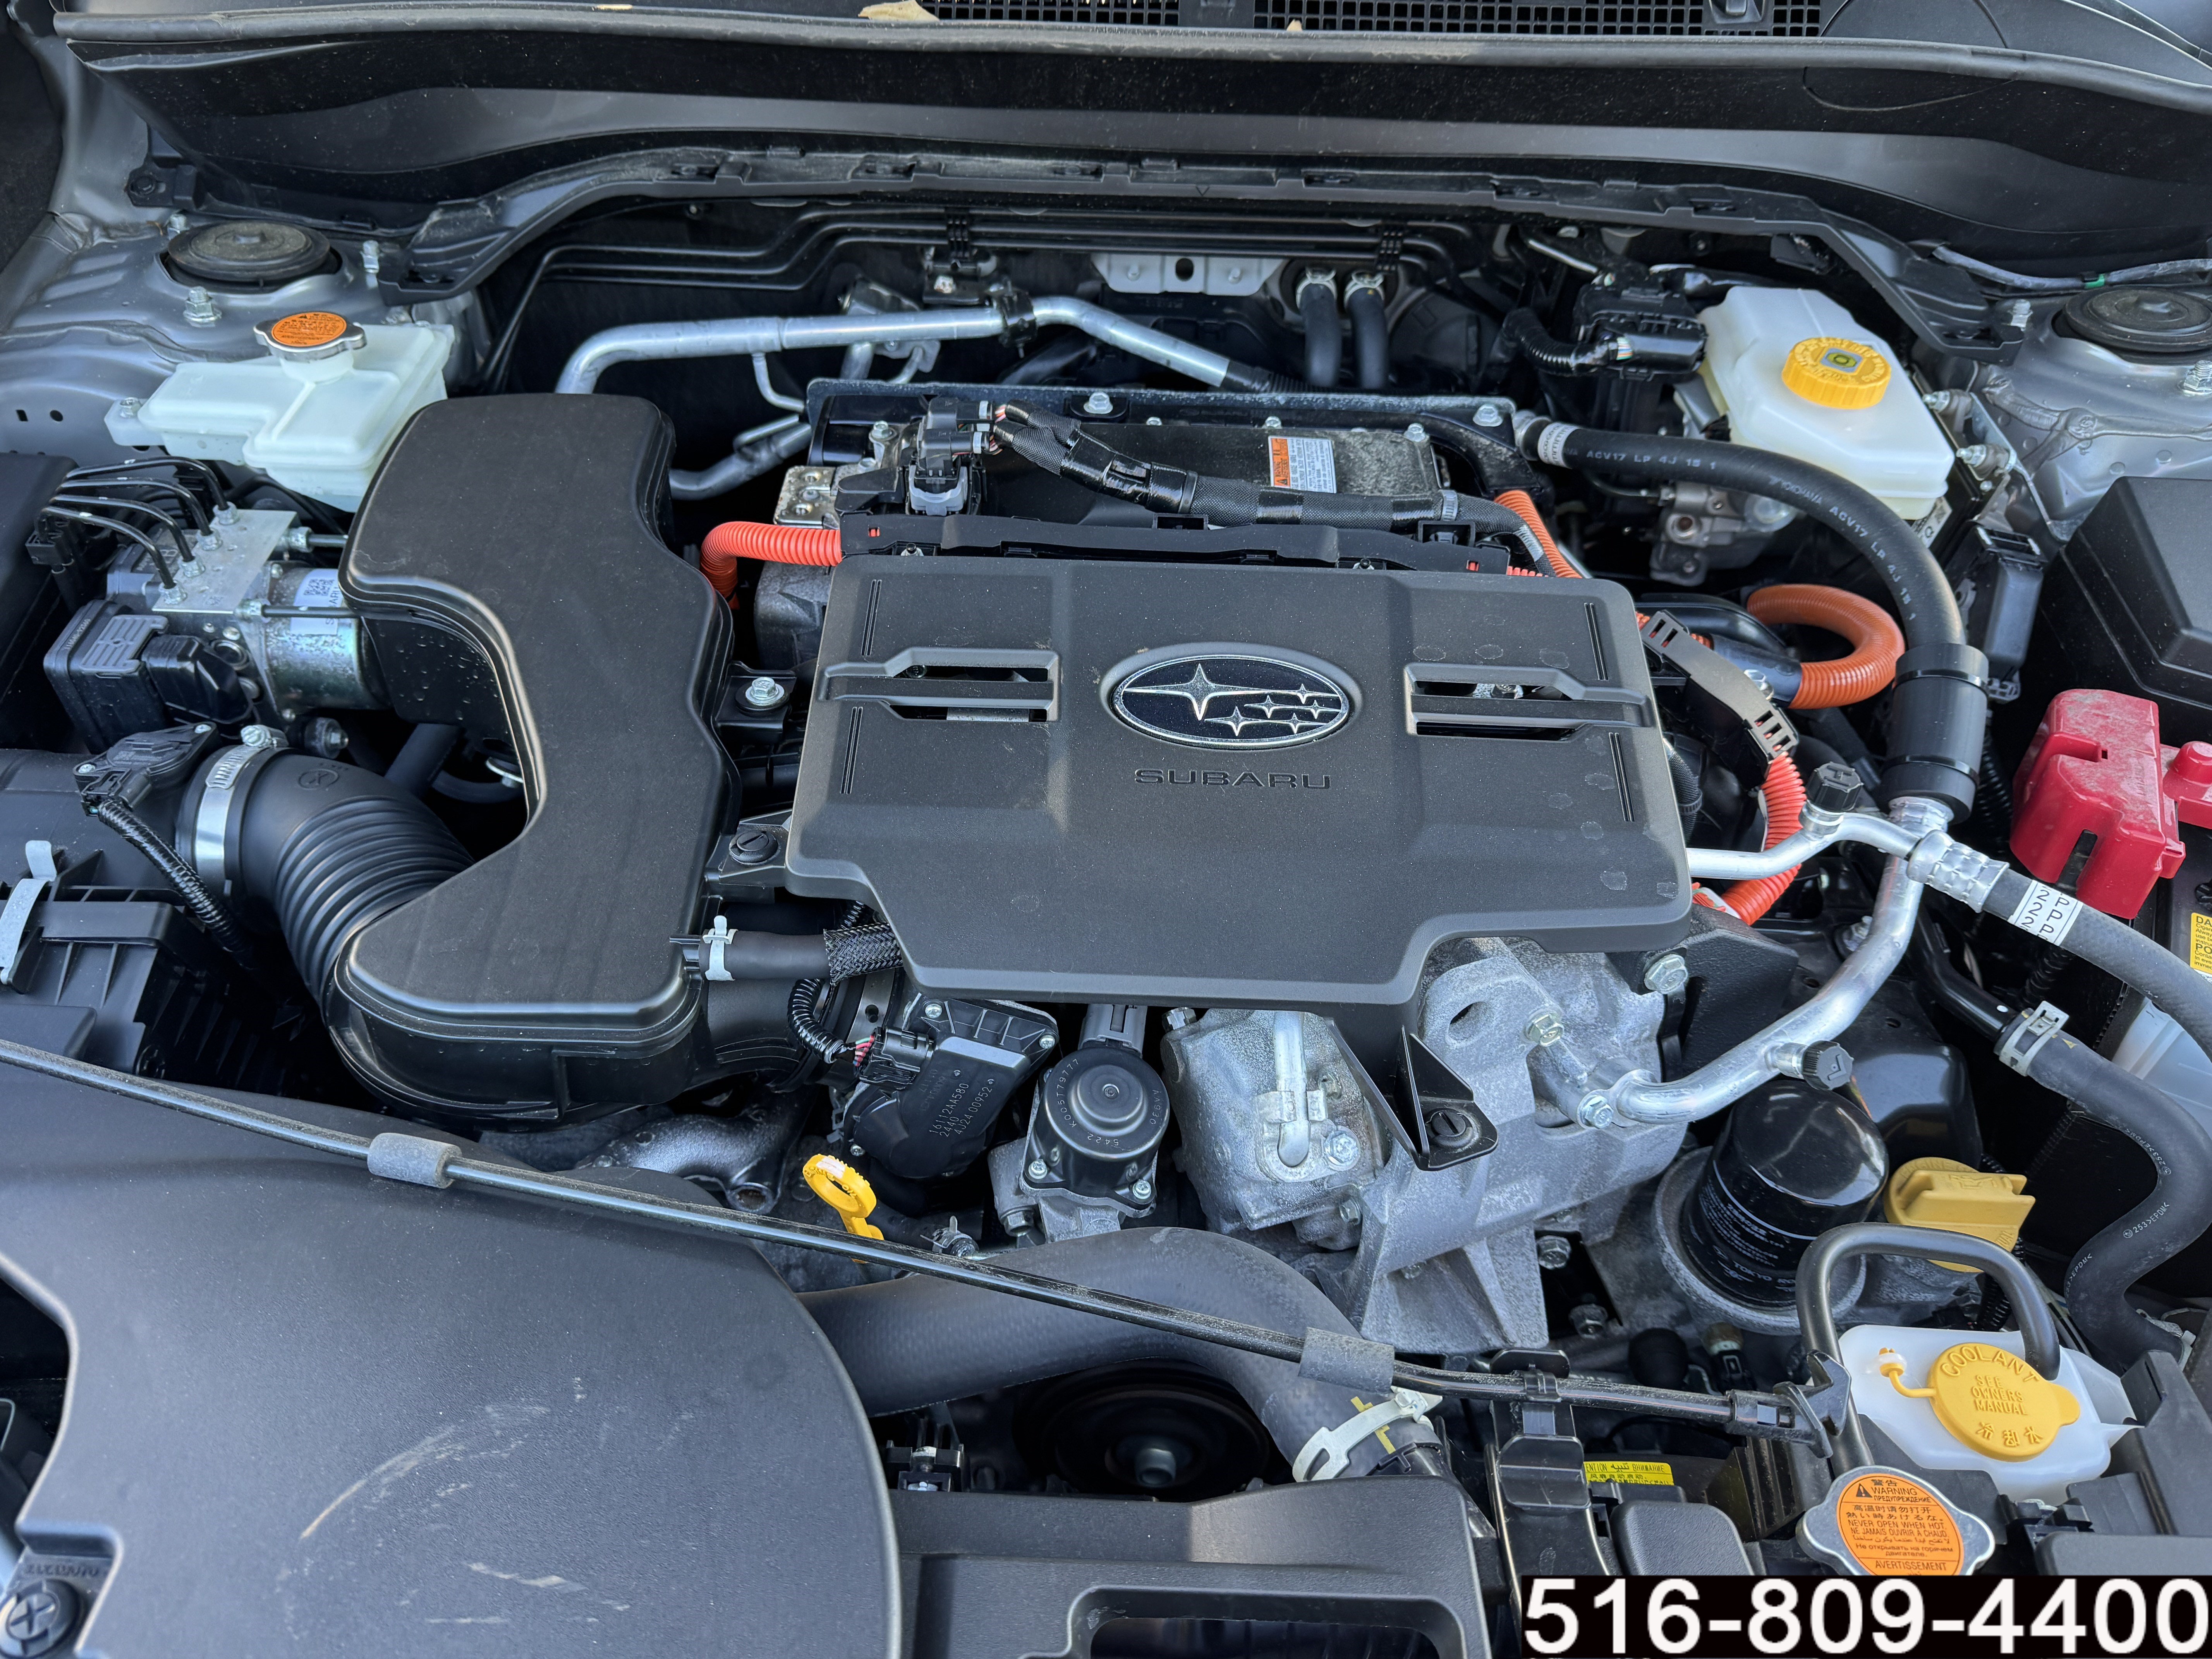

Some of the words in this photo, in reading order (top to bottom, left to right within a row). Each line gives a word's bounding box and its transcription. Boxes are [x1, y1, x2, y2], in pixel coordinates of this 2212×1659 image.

[1829, 507, 1868, 537] ACV17
[1135, 768, 1331, 789] SUBARU
[2036, 890, 2050, 902] 2
[2055, 896, 2069, 907] P
[2028, 902, 2042, 916] 2
[2046, 909, 2063, 921] P
[2021, 916, 2034, 928] 2
[2039, 924, 2054, 933] P
[929, 1083, 969, 1133] 16112AA580
[968, 1087, 992, 1112] 00952
[939, 1116, 959, 1137] 2440
[1941, 1346, 2040, 1382] COOLANT
[1976, 1375, 2003, 1388] SEE
[1972, 1386, 2024, 1402] OWNERS
[1975, 1400, 2028, 1415] MANUAL
[1585, 1463, 1607, 1472] ENTION
[1871, 1487, 1917, 1495] WARNING
[1875, 1560, 1946, 1571] AVERTISSEMENT
